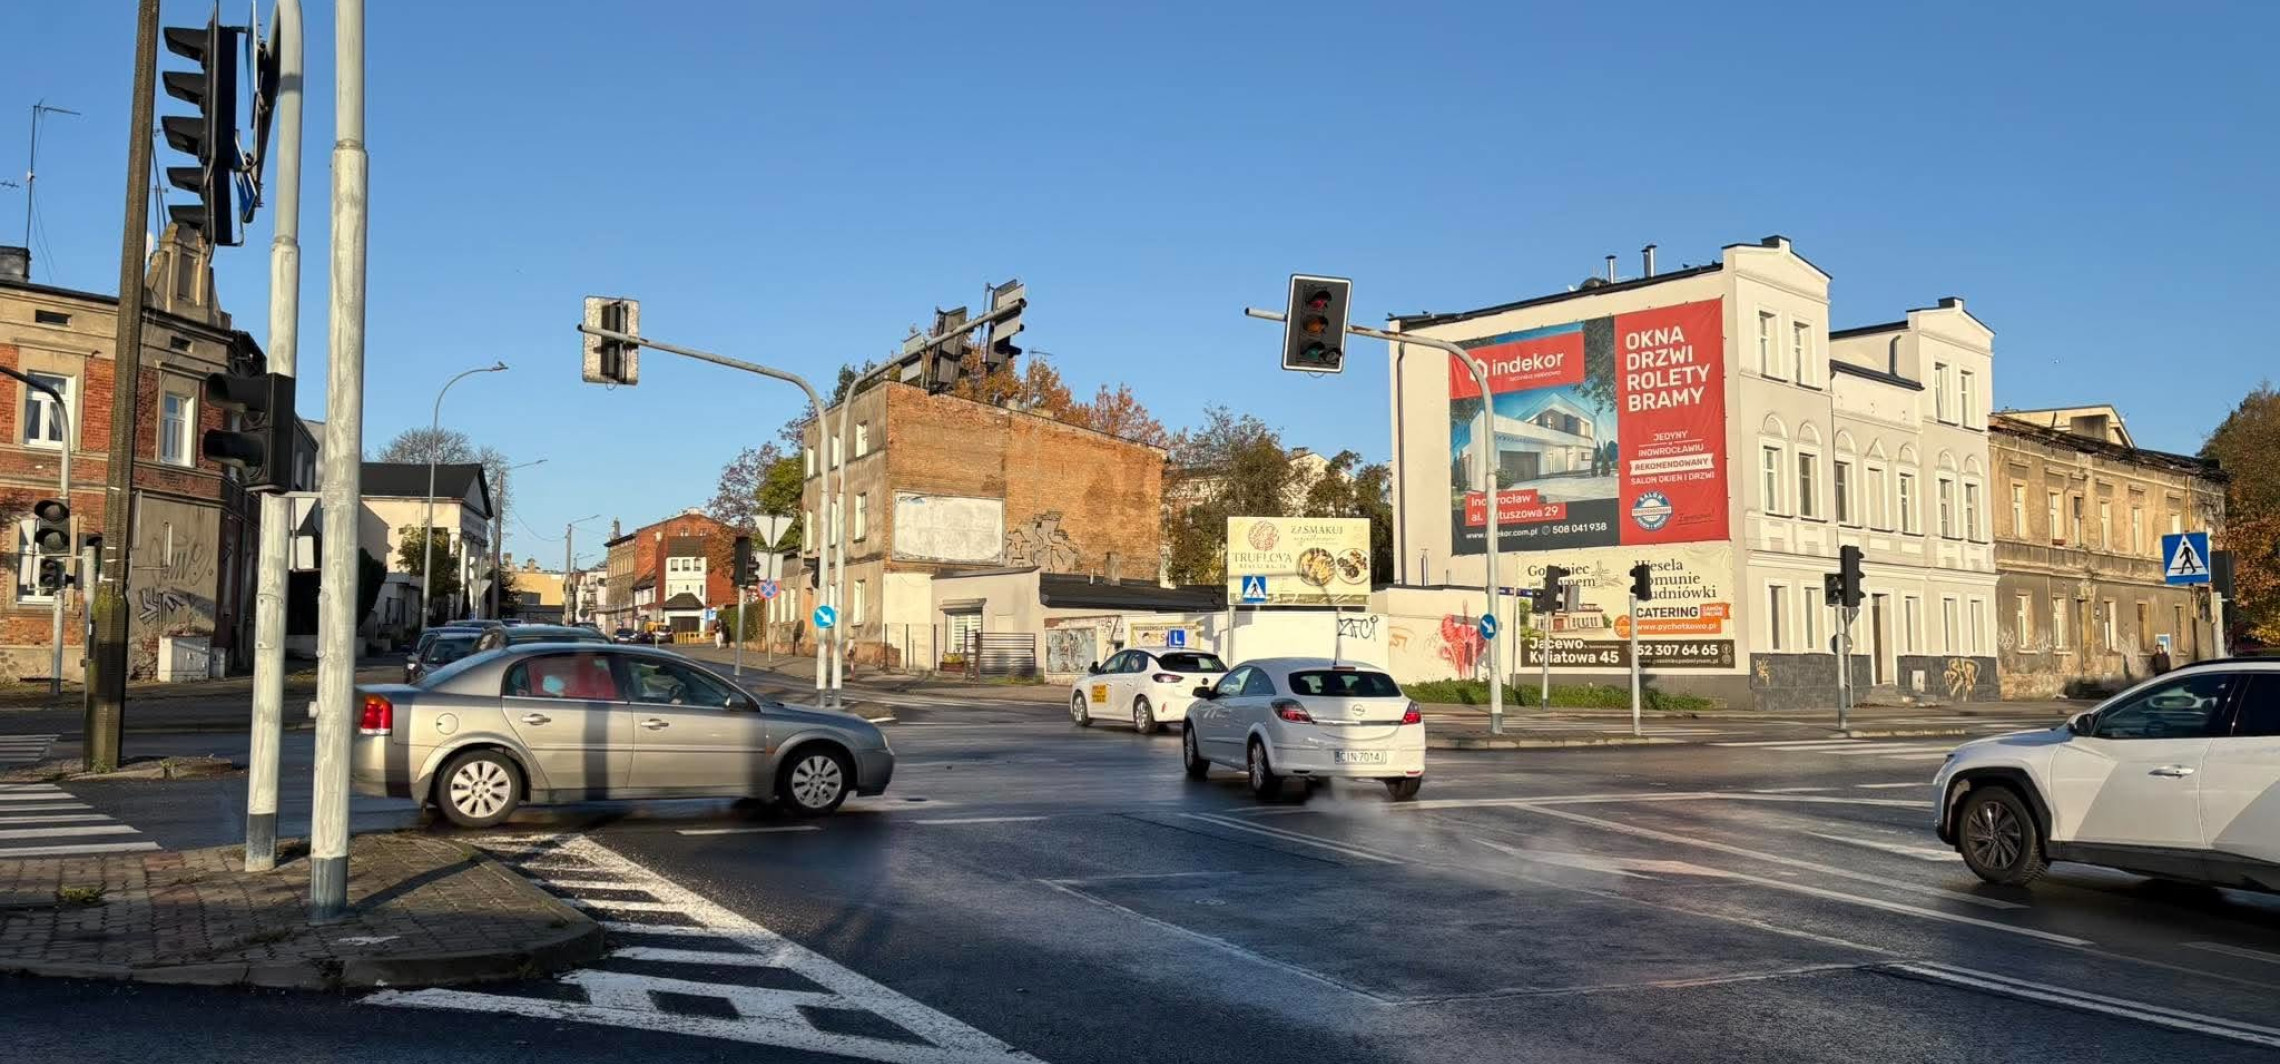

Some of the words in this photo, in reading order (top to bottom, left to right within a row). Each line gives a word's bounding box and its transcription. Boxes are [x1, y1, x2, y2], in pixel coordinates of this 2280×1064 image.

[1625, 325, 1685, 350] OKNA
[1492, 352, 1564, 376] indekor
[1626, 344, 1693, 371] DRZWI
[1626, 363, 1710, 391] ROLETY
[1627, 386, 1704, 412] BRAMY
[1653, 430, 1688, 441] JEDYNY
[1638, 443, 1704, 458] INOWROCŁAWIU
[1634, 457, 1709, 472] REKOMENDOWANY
[1630, 477, 1657, 486] SALON
[1658, 474, 1683, 483] OKIEN
[1688, 471, 1715, 480] DRZWI
[1471, 494, 1532, 507] Inorocław
[1471, 512, 1484, 522] al.
[1544, 506, 1559, 517] 29
[1552, 525, 1570, 535] 508
[1571, 524, 1588, 533] 041
[1589, 522, 1608, 532] 938
[1636, 606, 1699, 618] CATERING
[1599, 651, 1620, 664] 45
[1638, 644, 1653, 655] 52
[1654, 644, 1680, 656] 307
[1681, 644, 1699, 656] 64
[1701, 644, 1719, 656] 65
